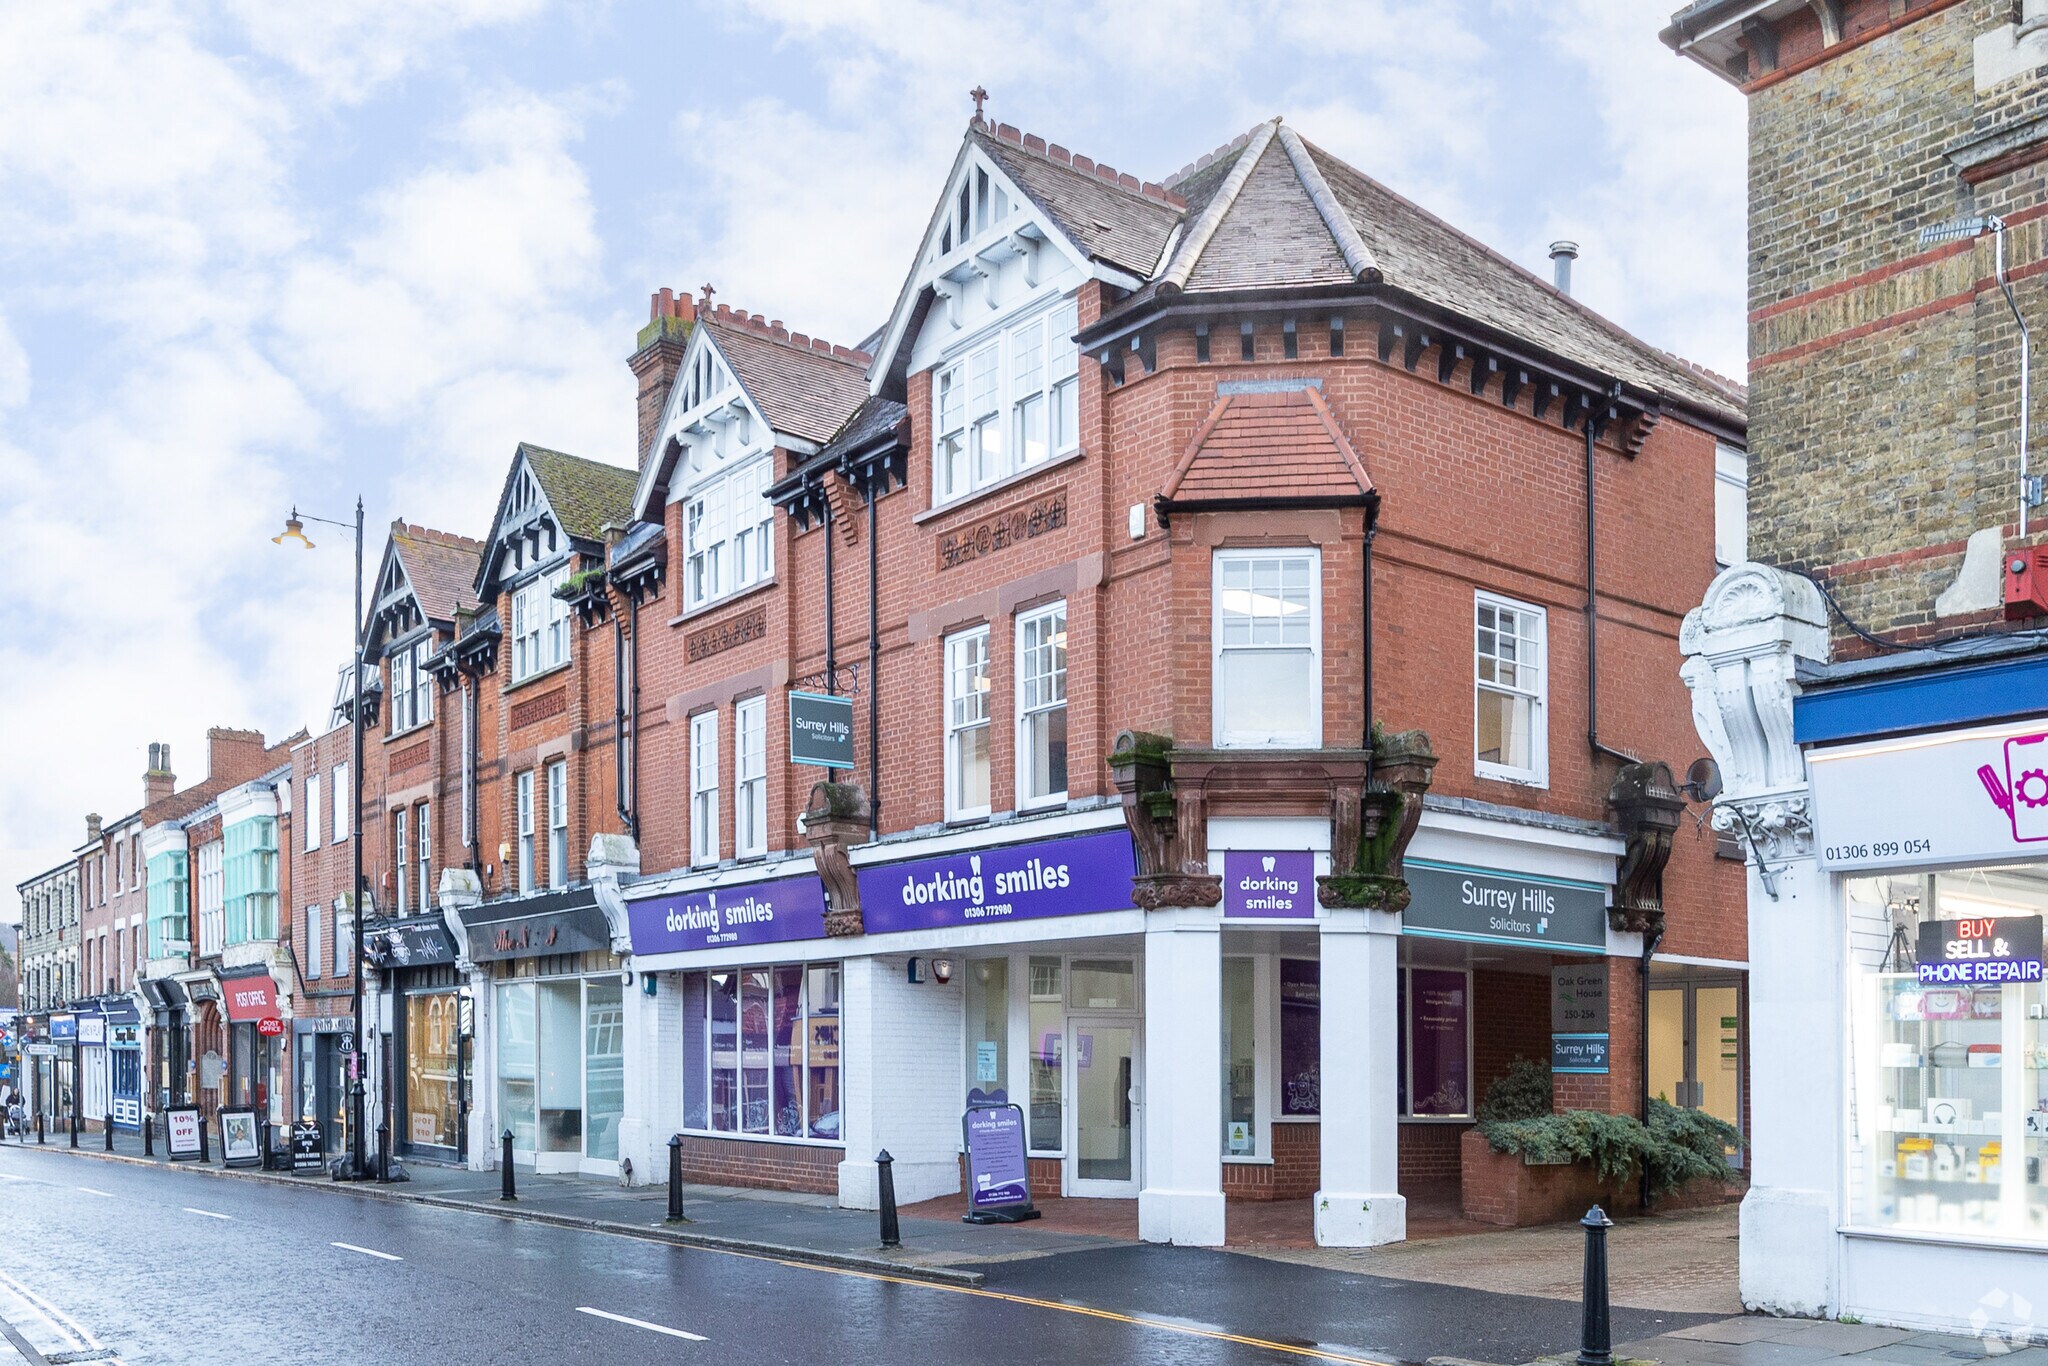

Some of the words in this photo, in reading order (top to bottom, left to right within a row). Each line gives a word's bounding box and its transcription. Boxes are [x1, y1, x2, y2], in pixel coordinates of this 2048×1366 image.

[796, 716, 827, 734] Surrey
[829, 721, 850, 734] Hills
[812, 733, 835, 742] Solicitors
[1826, 844, 1868, 861] 01306
[1873, 841, 1899, 856] 899
[1904, 839, 1931, 854] 054
[902, 871, 984, 905] dorking
[995, 858, 1070, 895] smiles
[1240, 876, 1298, 894] dorking
[1246, 895, 1293, 909] smiles
[1462, 880, 1517, 915] Surrey
[1522, 888, 1555, 914] Hills
[666, 905, 719, 933] dorking
[726, 897, 774, 926] smiles
[964, 906, 985, 918] 01306
[985, 904, 1012, 917] 772980
[1489, 917, 1531, 933] Solicitors
[1959, 919, 1996, 938] BUY
[706, 934, 720, 944] 01306
[720, 932, 738, 942] 772980
[1945, 939, 1991, 959] SELL
[1993, 937, 2010, 957] &
[1919, 963, 1973, 982] PHONE
[1975, 961, 2041, 980] REPAIR
[1558, 977, 1574, 986] Oak
[1577, 976, 1603, 986] Green
[235, 991, 249, 1007] POST
[248, 990, 267, 1006] OFFICE
[1576, 988, 1603, 998] House
[1564, 1010, 1596, 1019] 250-256
[260, 1025, 281, 1033] OFFICE
[1555, 1043, 1584, 1056] Surrey
[1586, 1043, 1605, 1054] Hills
[174, 1115, 194, 1123] 10%
[972, 1120, 996, 1129] dorking
[997, 1119, 1017, 1127] smiles
[176, 1128, 193, 1136] OFF
